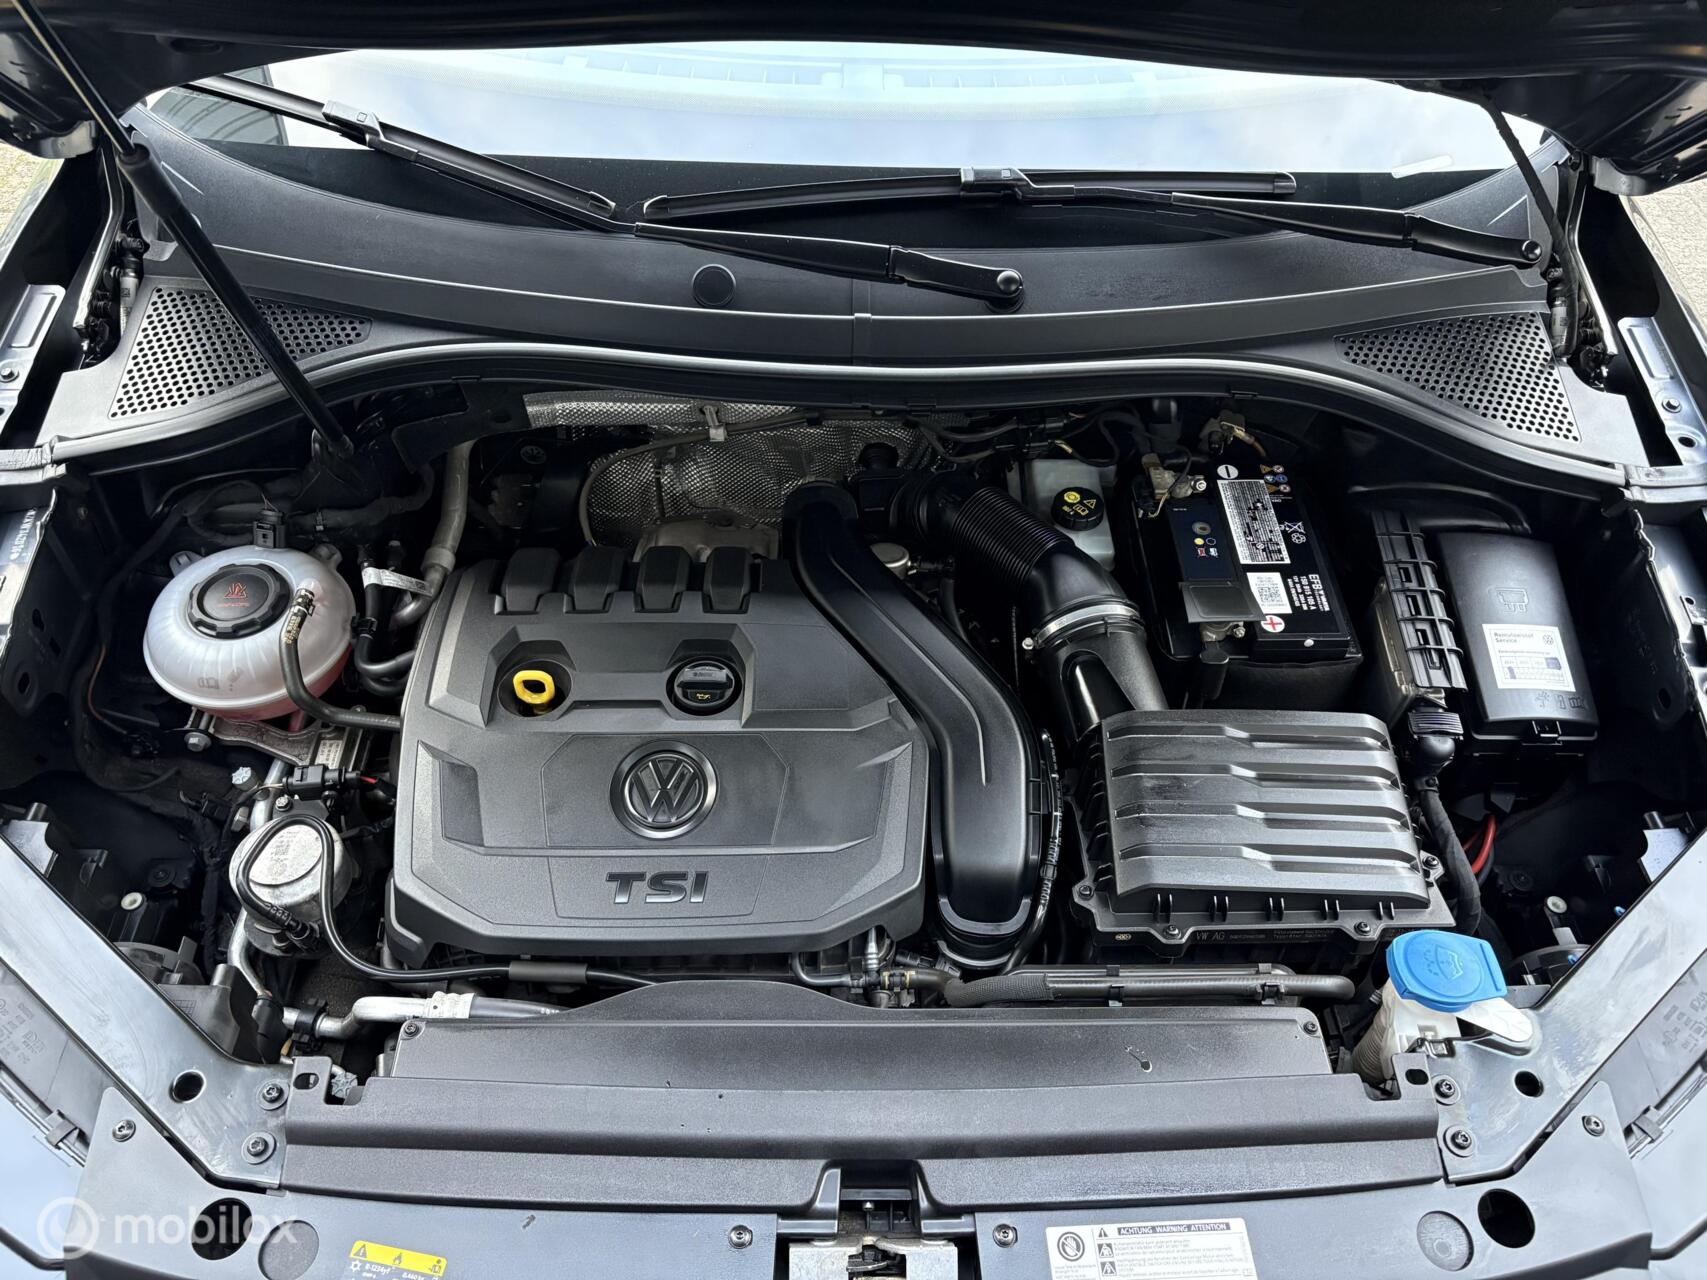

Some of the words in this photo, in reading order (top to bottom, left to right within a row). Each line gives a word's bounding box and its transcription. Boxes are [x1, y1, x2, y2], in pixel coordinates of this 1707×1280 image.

[1308, 574, 1323, 590] EFB
[606, 871, 709, 904] TSI
[1119, 1226, 1153, 1236] ACHTUNG
[1155, 1224, 1189, 1233] WARNING
[1190, 1223, 1227, 1232] ATTENTION
